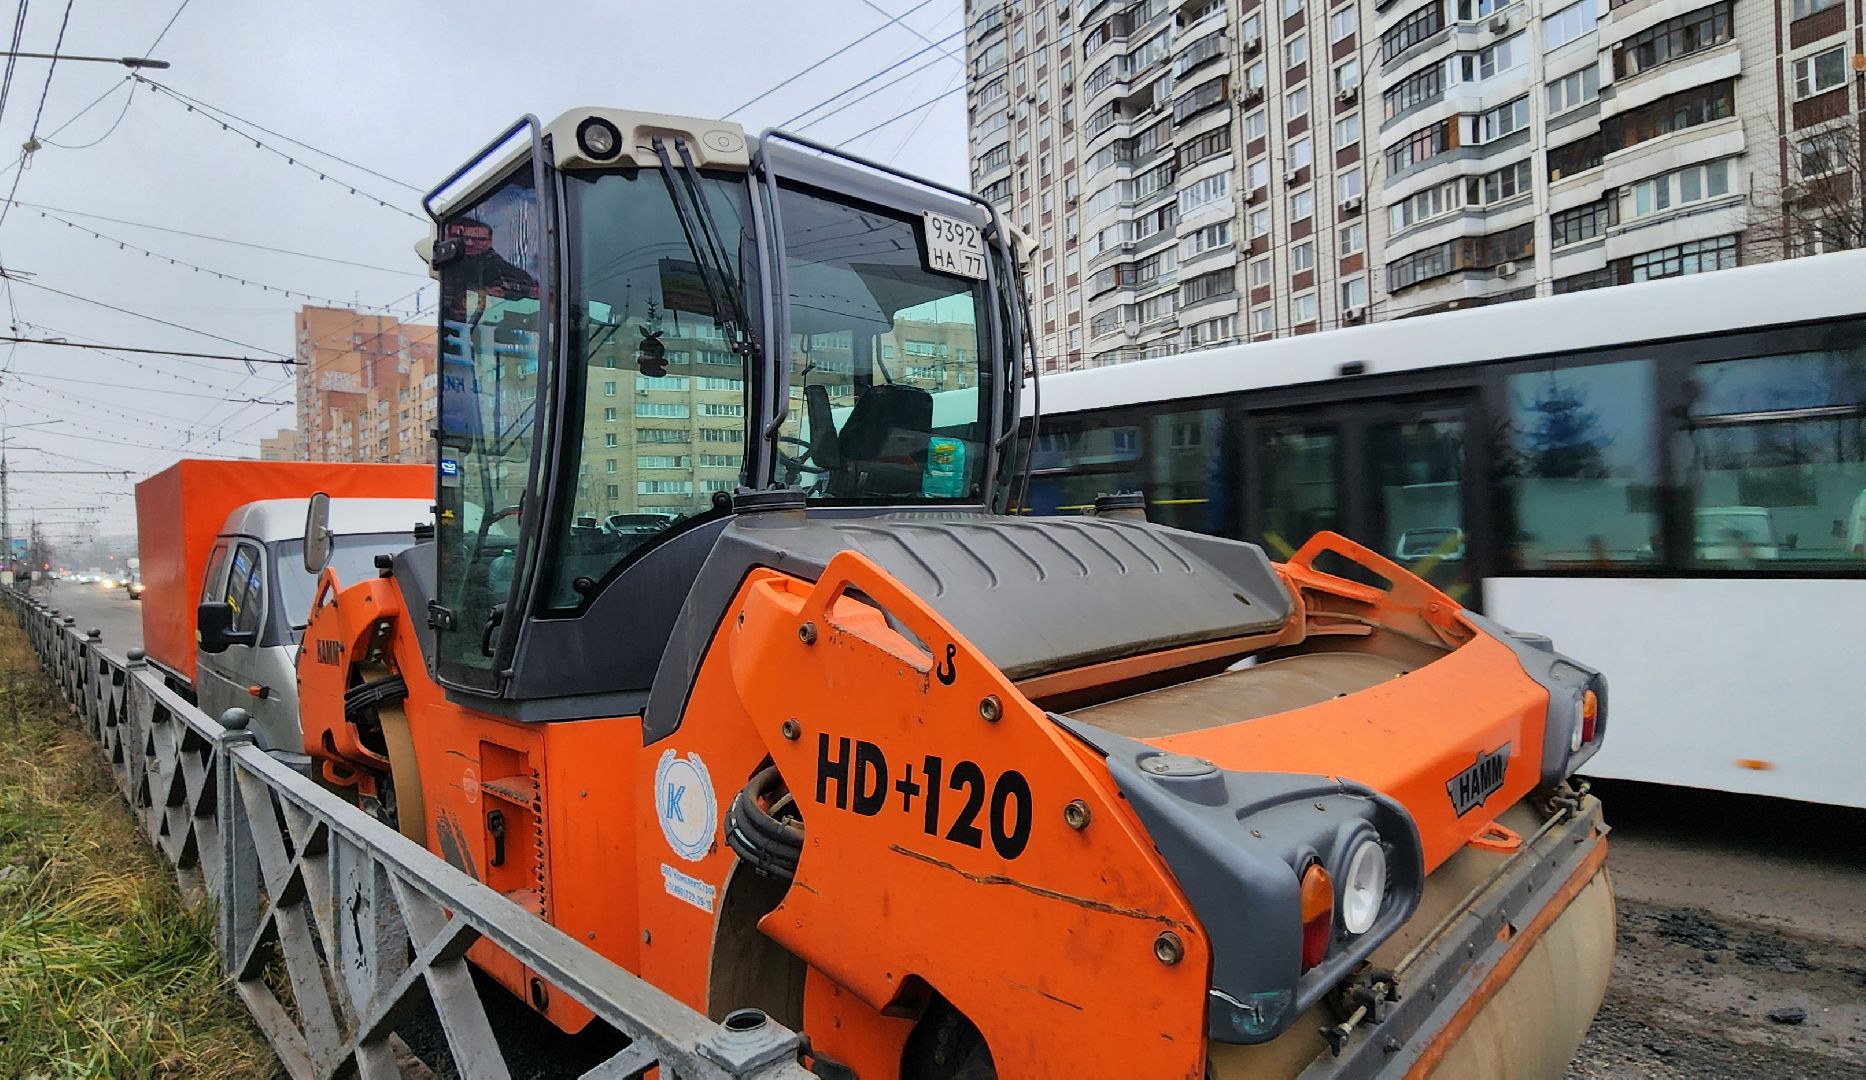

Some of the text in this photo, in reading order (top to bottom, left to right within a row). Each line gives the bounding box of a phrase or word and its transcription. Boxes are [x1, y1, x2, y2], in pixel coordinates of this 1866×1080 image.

[932, 217, 977, 249] 9392
[934, 248, 981, 275] НА 77
[815, 732, 1034, 861] HD+120
[1459, 754, 1503, 808] HAMM
